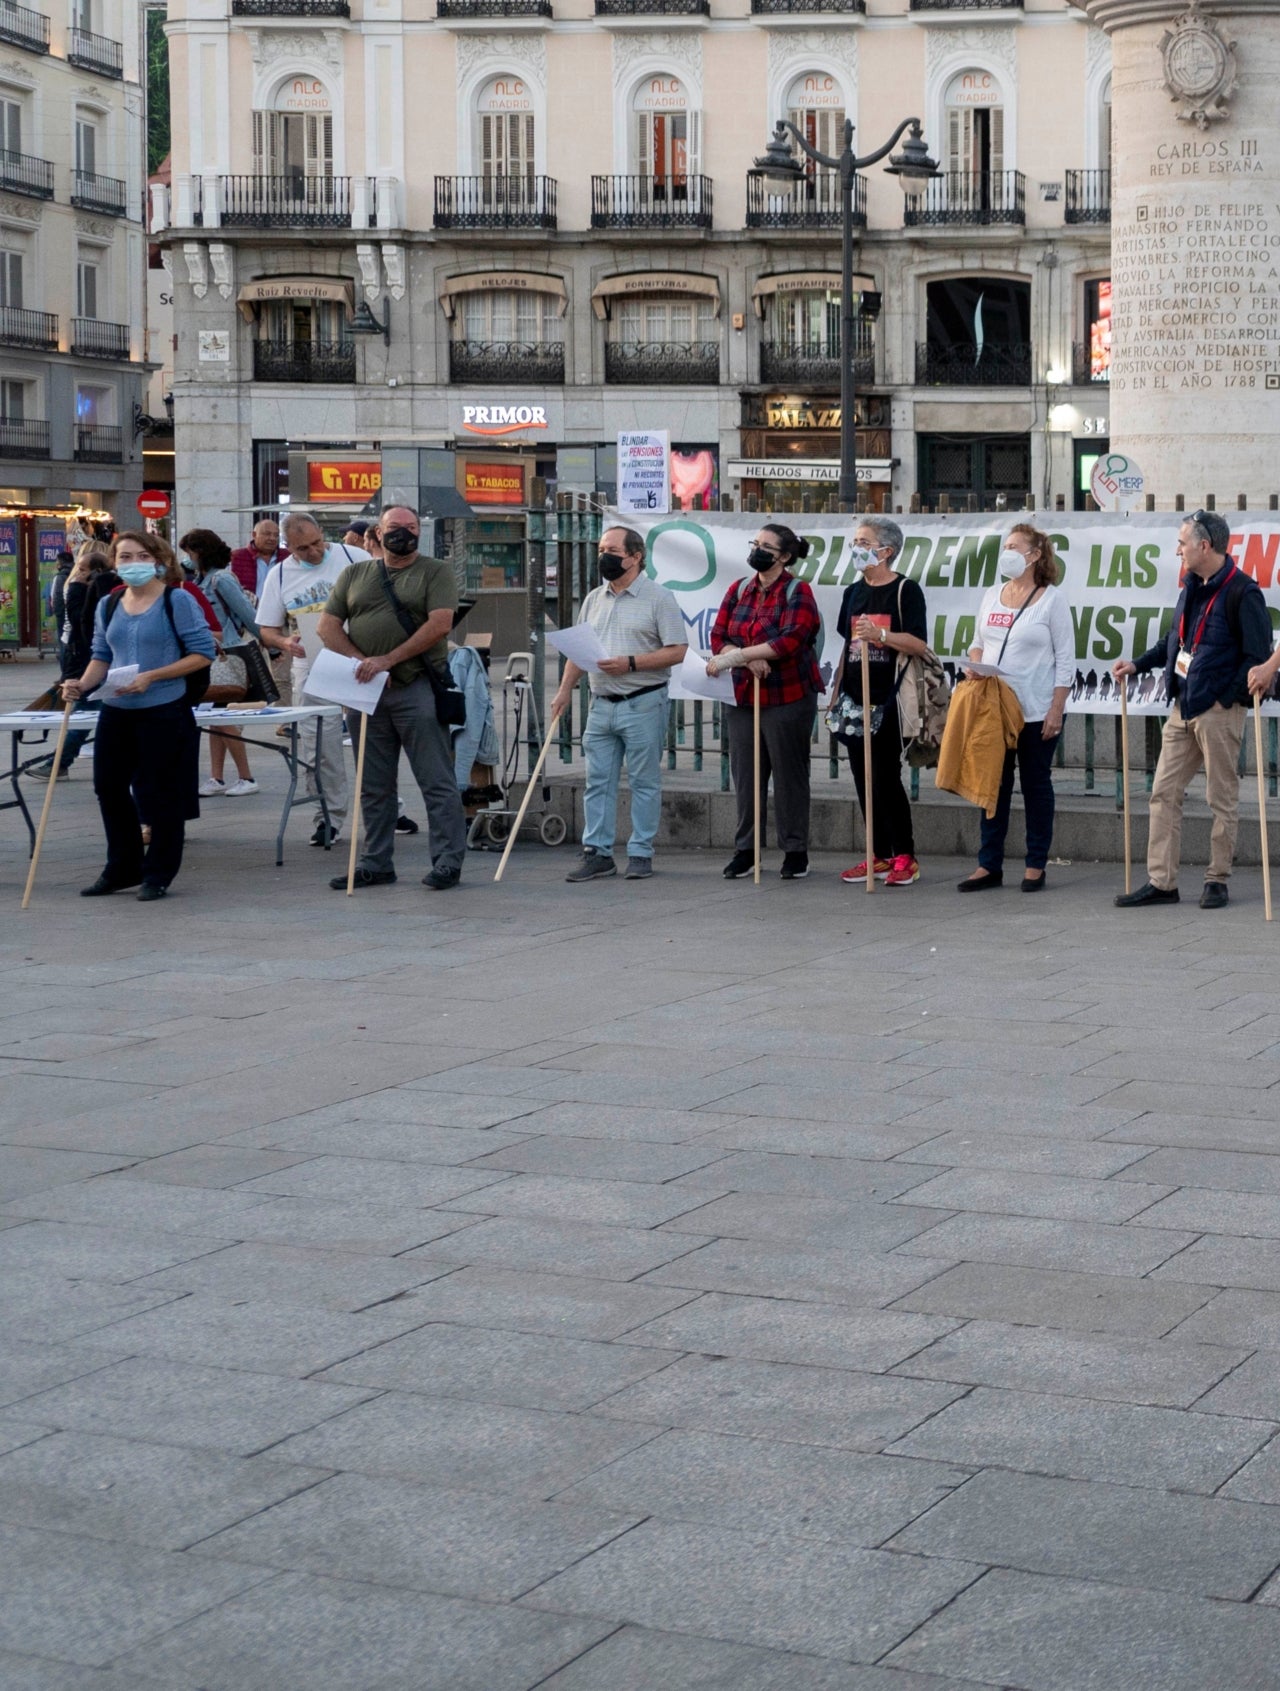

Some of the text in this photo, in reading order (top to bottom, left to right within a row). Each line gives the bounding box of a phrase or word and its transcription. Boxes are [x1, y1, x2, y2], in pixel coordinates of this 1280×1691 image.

[1157, 140, 1257, 159] CARLOS III
[1150, 157, 1263, 176] REY DE ESPAÑA
[1154, 205, 1185, 218] HIJO
[1195, 205, 1210, 216] DE
[1219, 205, 1264, 216] FELIPE
[1186, 220, 1268, 233] FERNANDO
[1177, 235, 1280, 248] FORTALECIO
[1189, 251, 1270, 264] PATROCINO
[1159, 268, 1175, 280] LA
[1186, 266, 1255, 278] REFORMA
[482, 278, 527, 287] RELOJES
[777, 281, 844, 289] HERRAMIENT
[1174, 281, 1240, 294] PROPICIO
[1249, 281, 1266, 293] LA
[1120, 302, 1133, 314] DE
[1138, 298, 1221, 312] MERCANCIAS
[1233, 298, 1241, 309] Y
[1140, 314, 1153, 326] DE
[1161, 313, 1236, 326] COMERCIO
[1247, 313, 1277, 325] CON
[1134, 329, 1194, 341] AVSTRALIA
[1115, 345, 1185, 358] AMERICANAS
[1195, 344, 1267, 357] MEDIANTE
[1112, 360, 1195, 374] CONSTRVCCION
[1204, 360, 1223, 372] DE
[1133, 377, 1146, 389] EN
[1154, 375, 1169, 388] EL
[1180, 372, 1212, 387] AÑO
[1224, 376, 1256, 387] 1788
[463, 406, 547, 424] PRIMOR
[767, 409, 858, 429] PALAZZ
[621, 436, 648, 446] BLINDAR
[629, 446, 663, 457] PENSIONES
[747, 467, 873, 480] HELADOS ITALIOS
[481, 477, 520, 489] TABACOS
[1087, 544, 1161, 588] LAS
[988, 613, 1012, 625] USO
